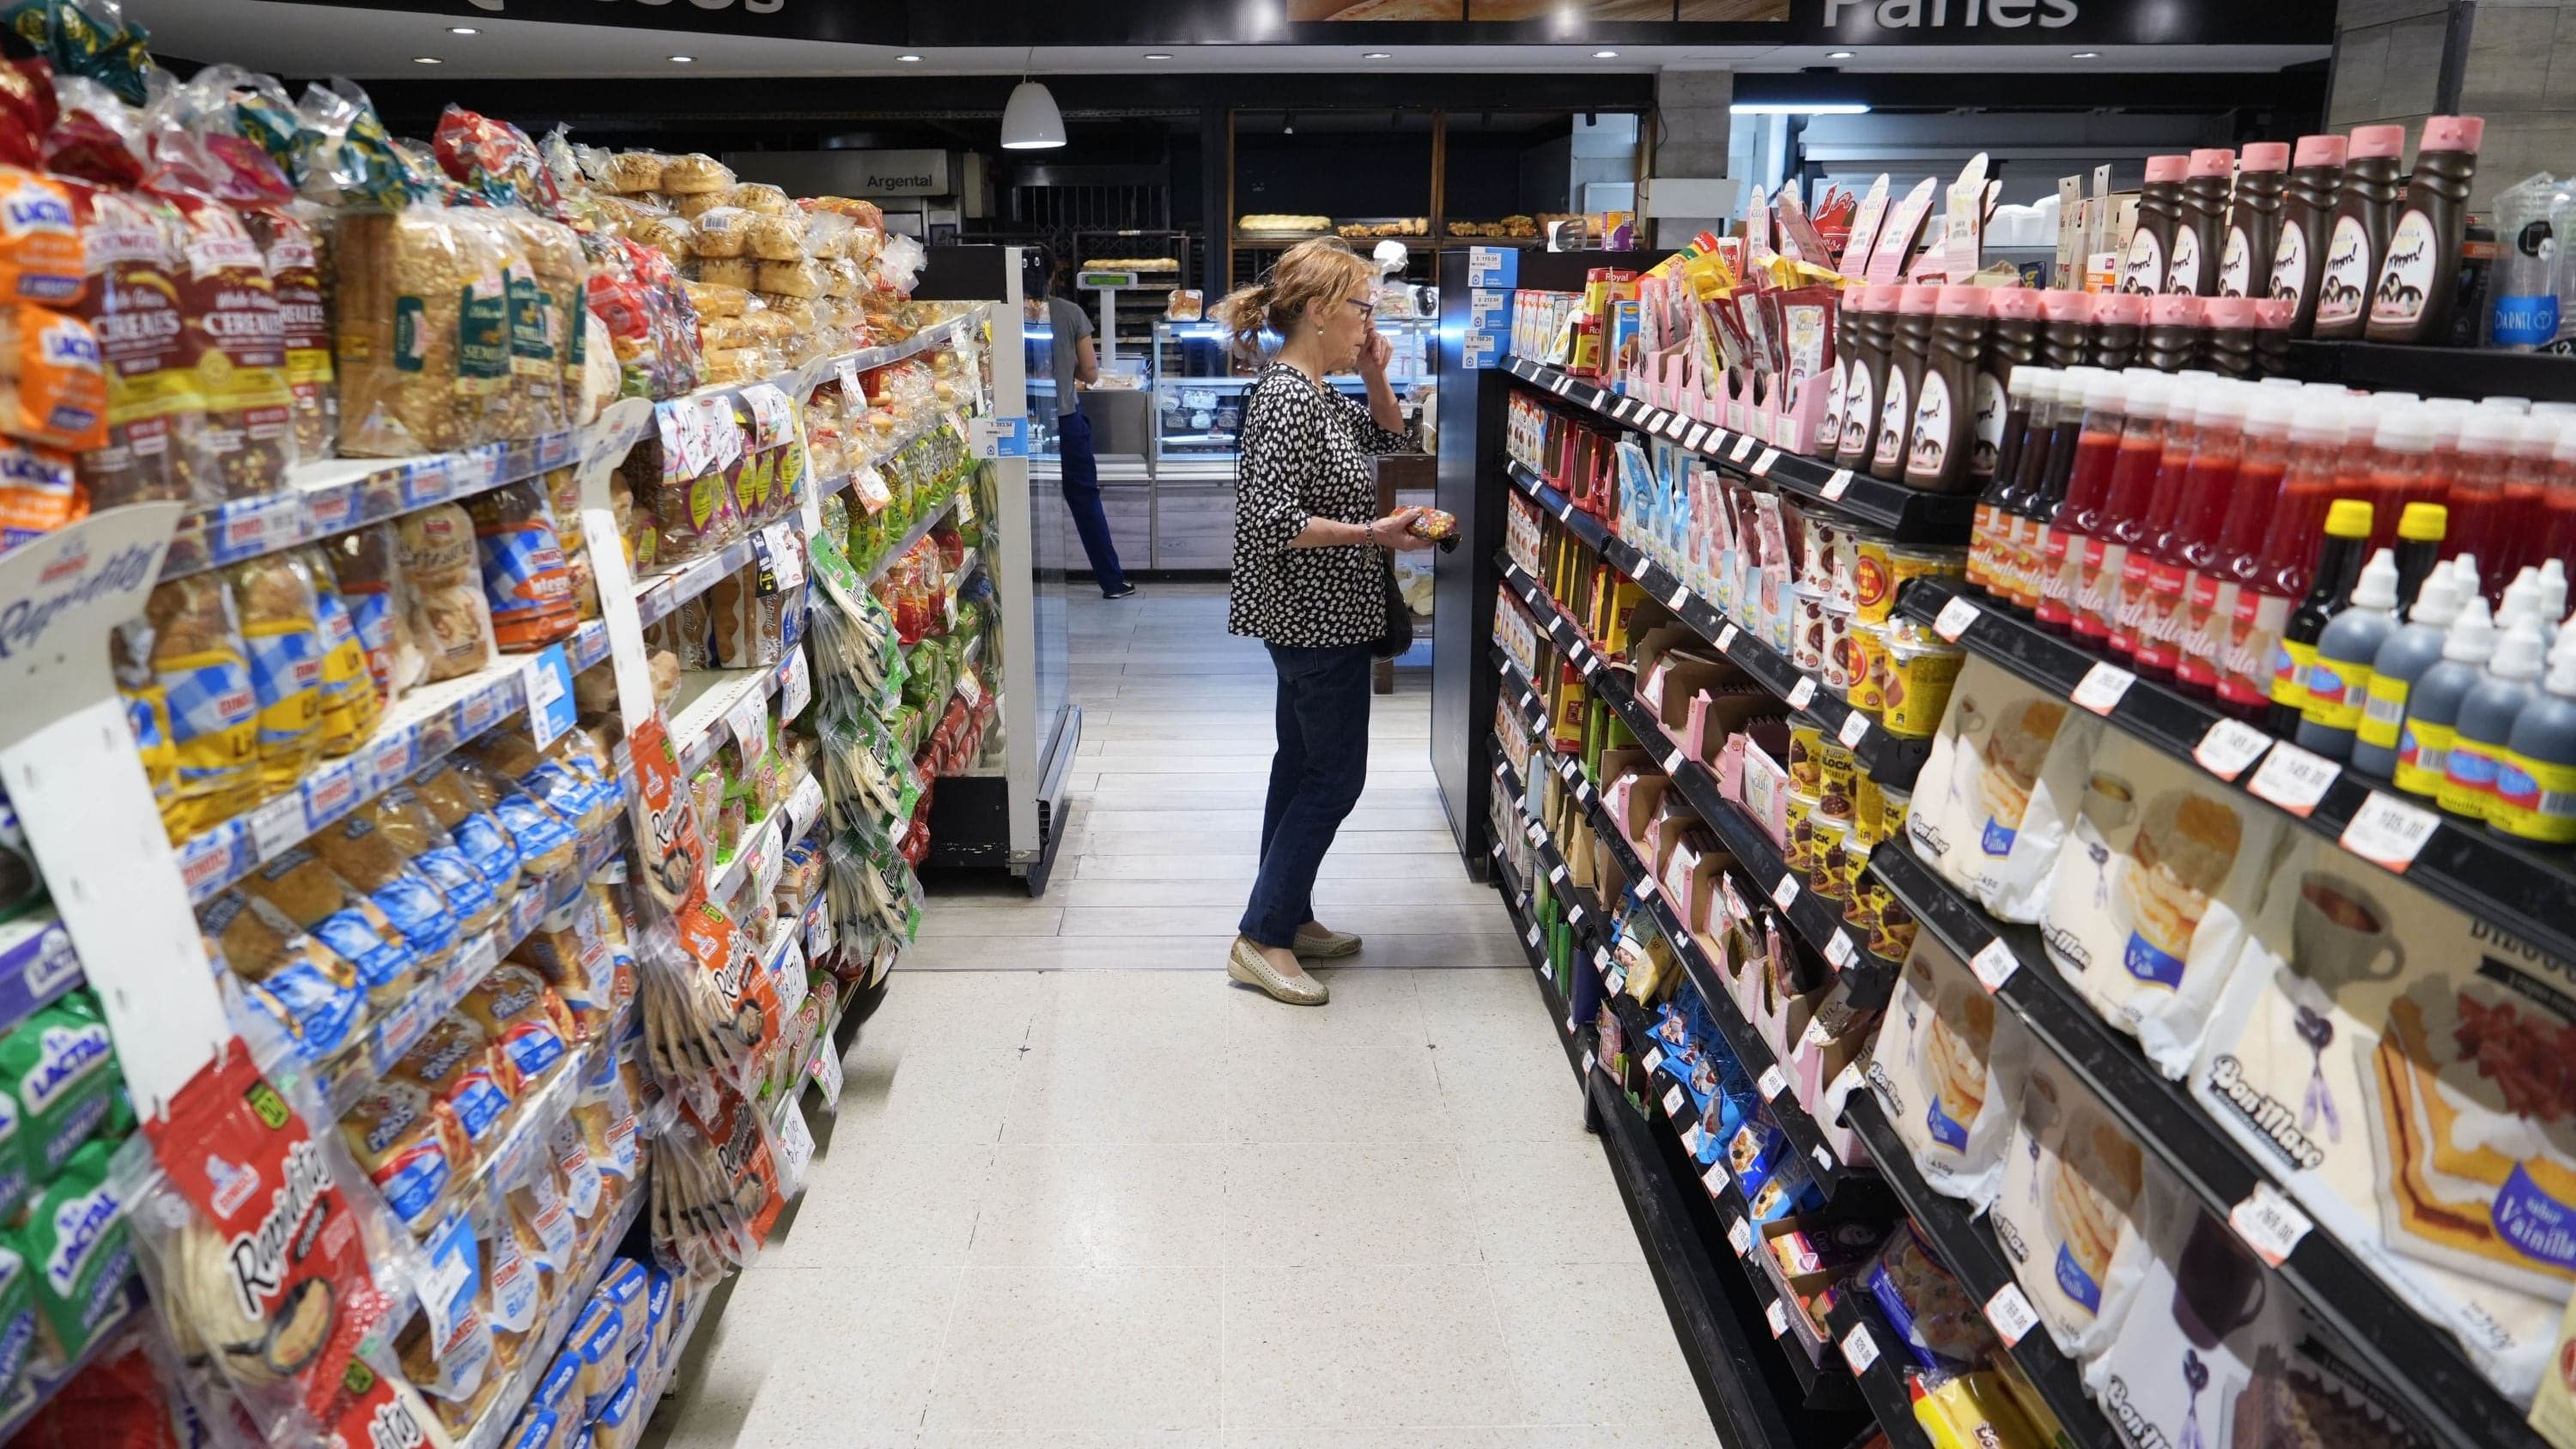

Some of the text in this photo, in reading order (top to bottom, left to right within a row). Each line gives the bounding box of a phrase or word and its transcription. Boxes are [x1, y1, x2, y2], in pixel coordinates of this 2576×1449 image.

[866, 174, 933, 191] Argental
[1605, 272, 1629, 282] Royal
[2494, 310, 2531, 331] DARNEL
[33, 1032, 110, 1099] LACTAL
[55, 1191, 119, 1279] LACTAL
